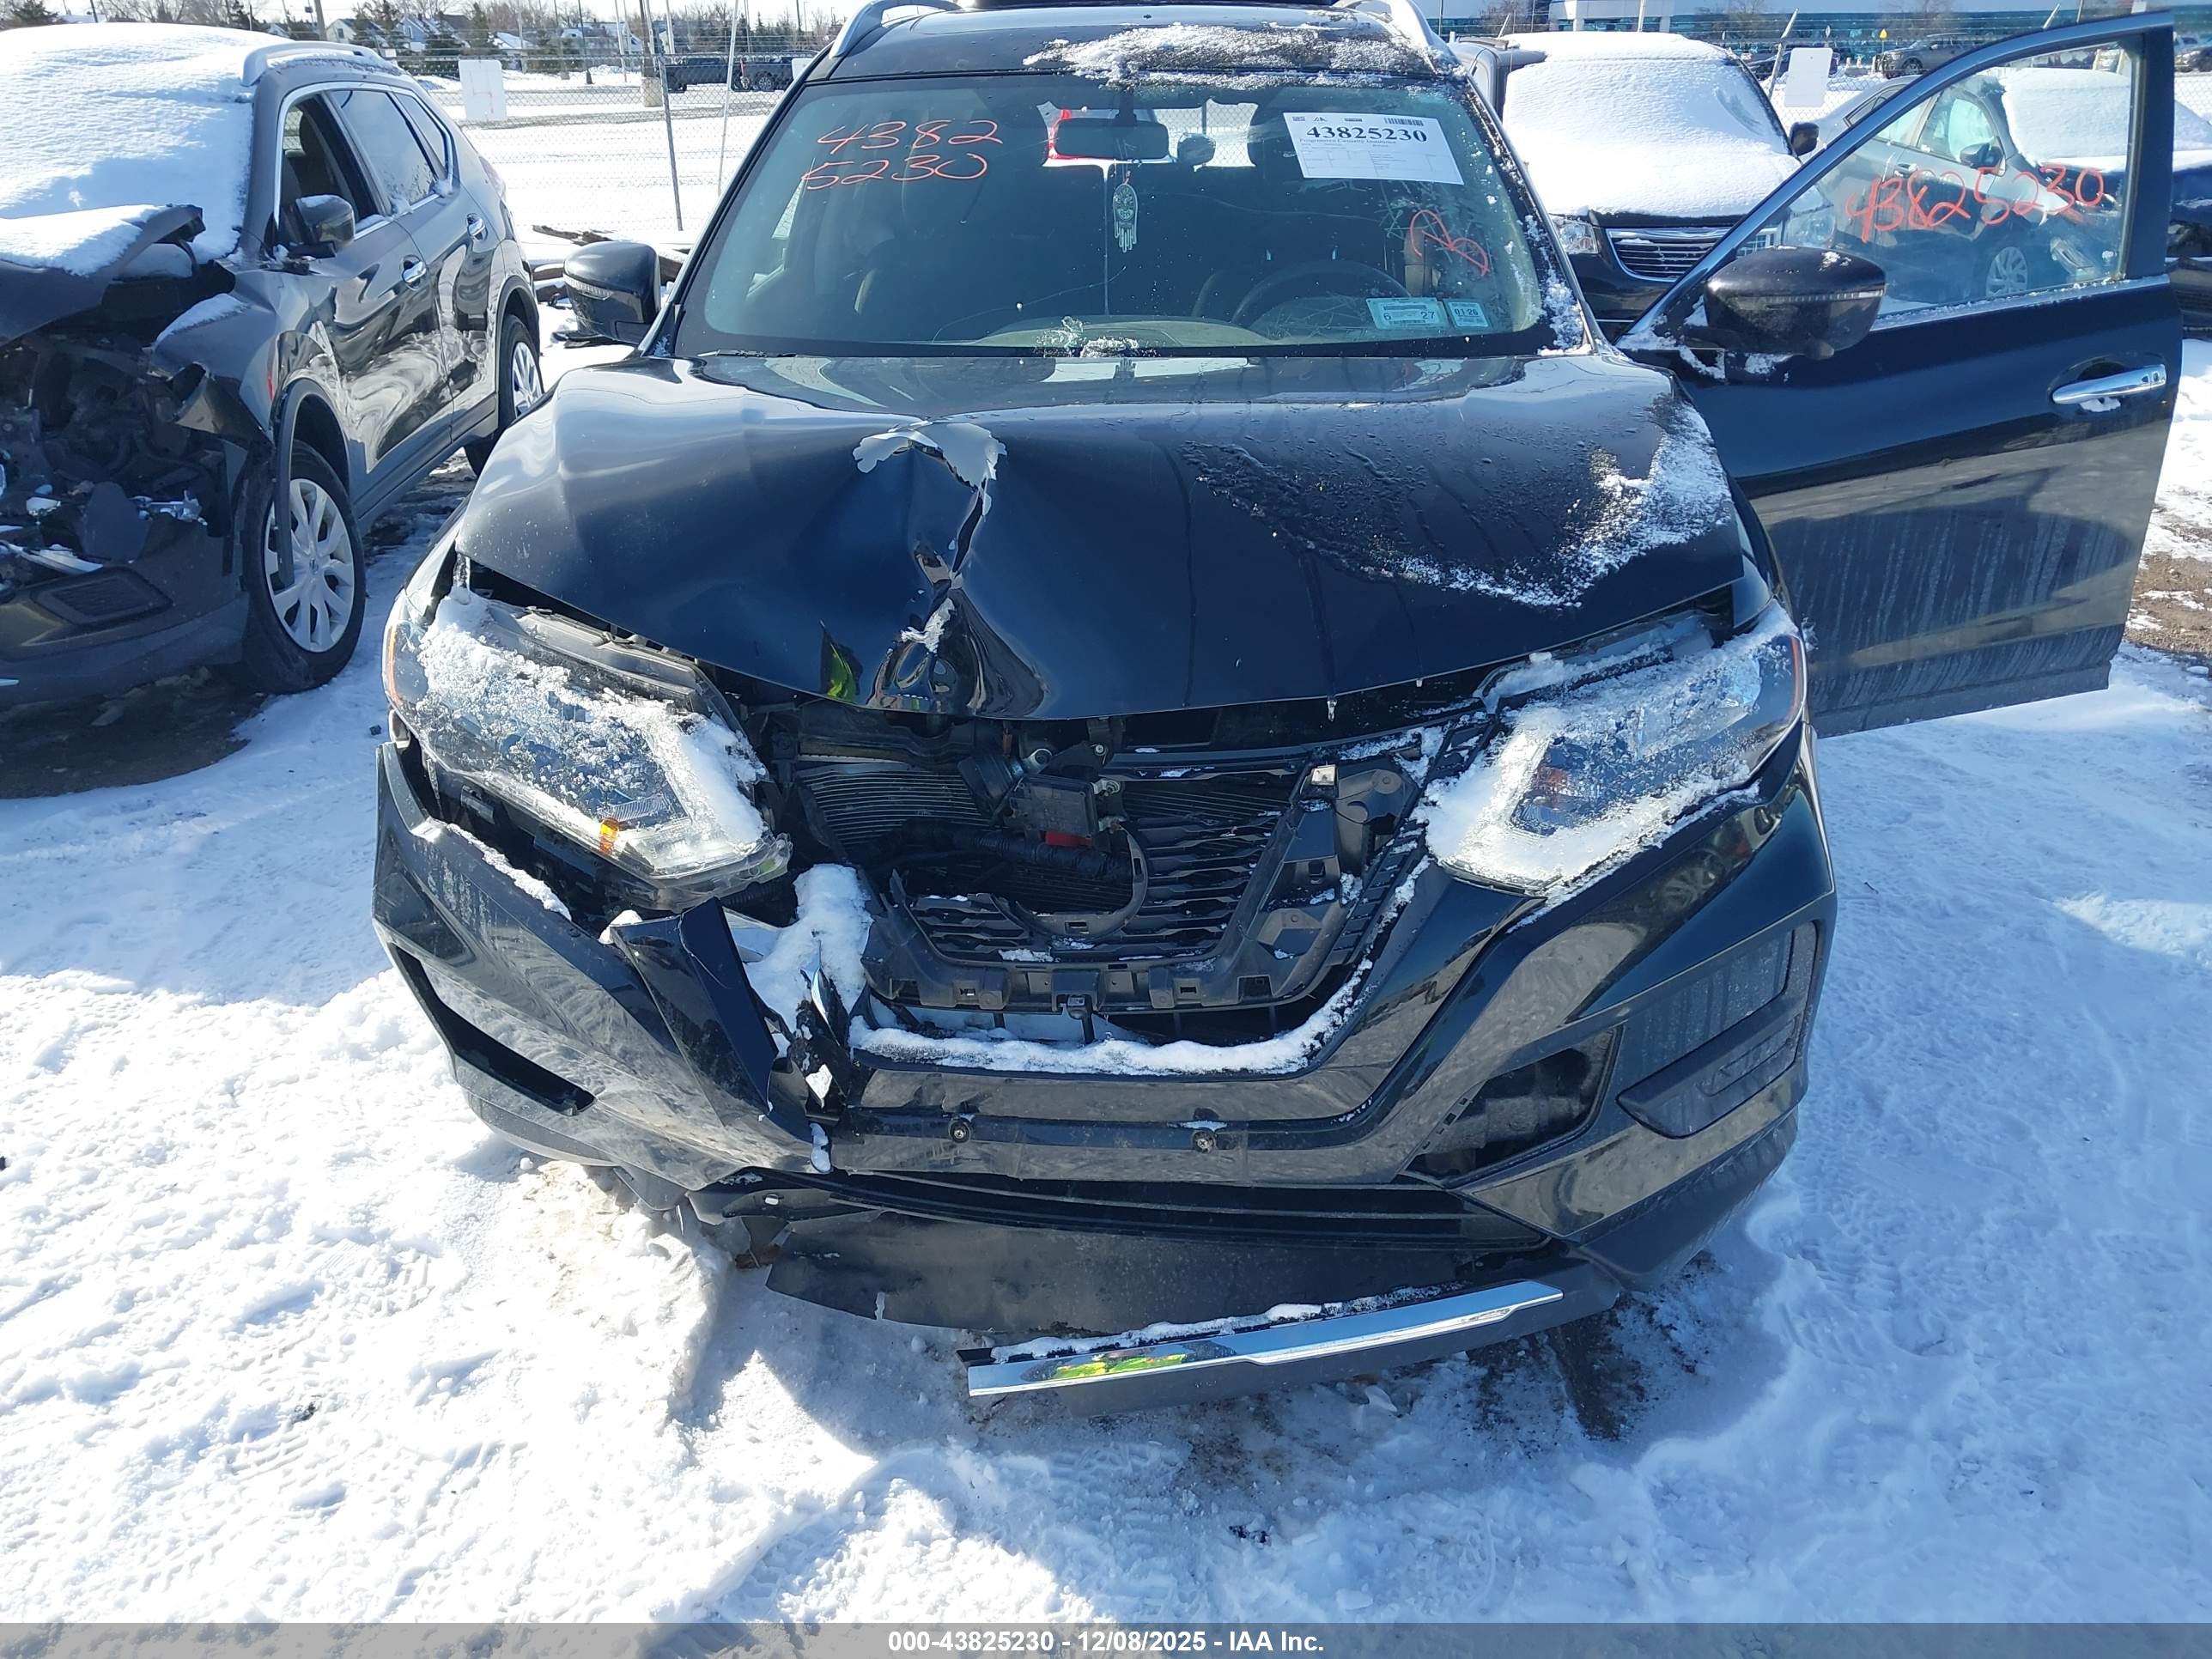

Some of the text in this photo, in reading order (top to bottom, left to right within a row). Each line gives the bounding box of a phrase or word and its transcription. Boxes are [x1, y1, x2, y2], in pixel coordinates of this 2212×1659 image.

[817, 119, 1004, 155] 4382
[1306, 125, 1428, 143] 43825230
[801, 152, 988, 190] 5230
[1420, 311, 1436, 319] 27
